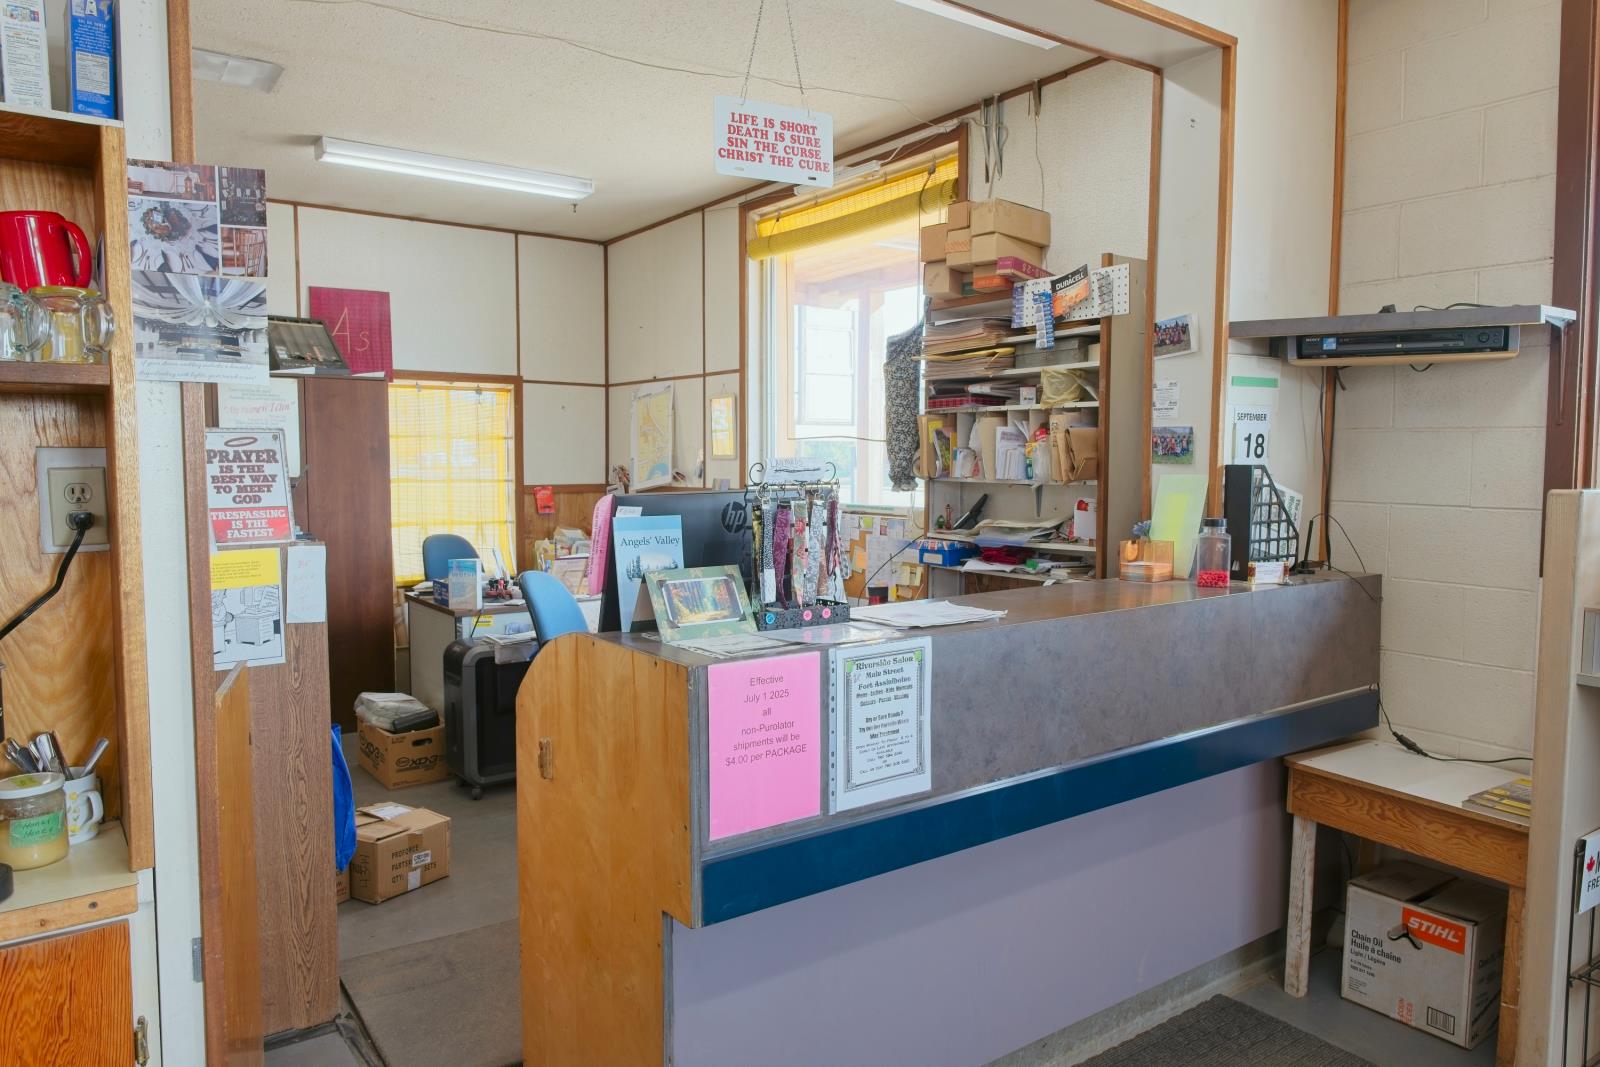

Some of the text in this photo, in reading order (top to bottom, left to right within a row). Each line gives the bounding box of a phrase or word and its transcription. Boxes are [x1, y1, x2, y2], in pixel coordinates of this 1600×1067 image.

[731, 112, 817, 136] LIFE IS SHORT
[728, 124, 821, 148] DEATH IS SURE
[727, 136, 821, 160] SIN THE CURSE
[718, 148, 830, 172] CHRIST THE CURE
[1056, 271, 1084, 290] DURACELL
[1237, 412, 1267, 421] SEPTEMBER
[1244, 432, 1264, 458] 18
[206, 449, 279, 464] PRAYER
[219, 465, 264, 474] IS THE
[210, 474, 278, 484] BEST WAY
[214, 484, 273, 494] TO MEET
[232, 494, 262, 504] GOD
[210, 510, 285, 520] TRESPASSING
[725, 501, 746, 533] hp
[232, 519, 268, 528] IS THE
[227, 528, 274, 538] FASTEST
[654, 536, 680, 546] Valley
[856, 656, 913, 670] Riverside Salon
[883, 667, 904, 675] Street
[750, 676, 784, 686] Effective
[744, 689, 789, 704] July 1 2025
[762, 707, 772, 716] all
[742, 721, 794, 735] non-Purolator
[733, 733, 800, 752] shipments will be
[725, 744, 807, 767] $4.00 per PACKAGE
[1408, 916, 1459, 943] STIHL
[1351, 929, 1383, 948] Chain Oil
[1351, 938, 1370, 952] Huile
